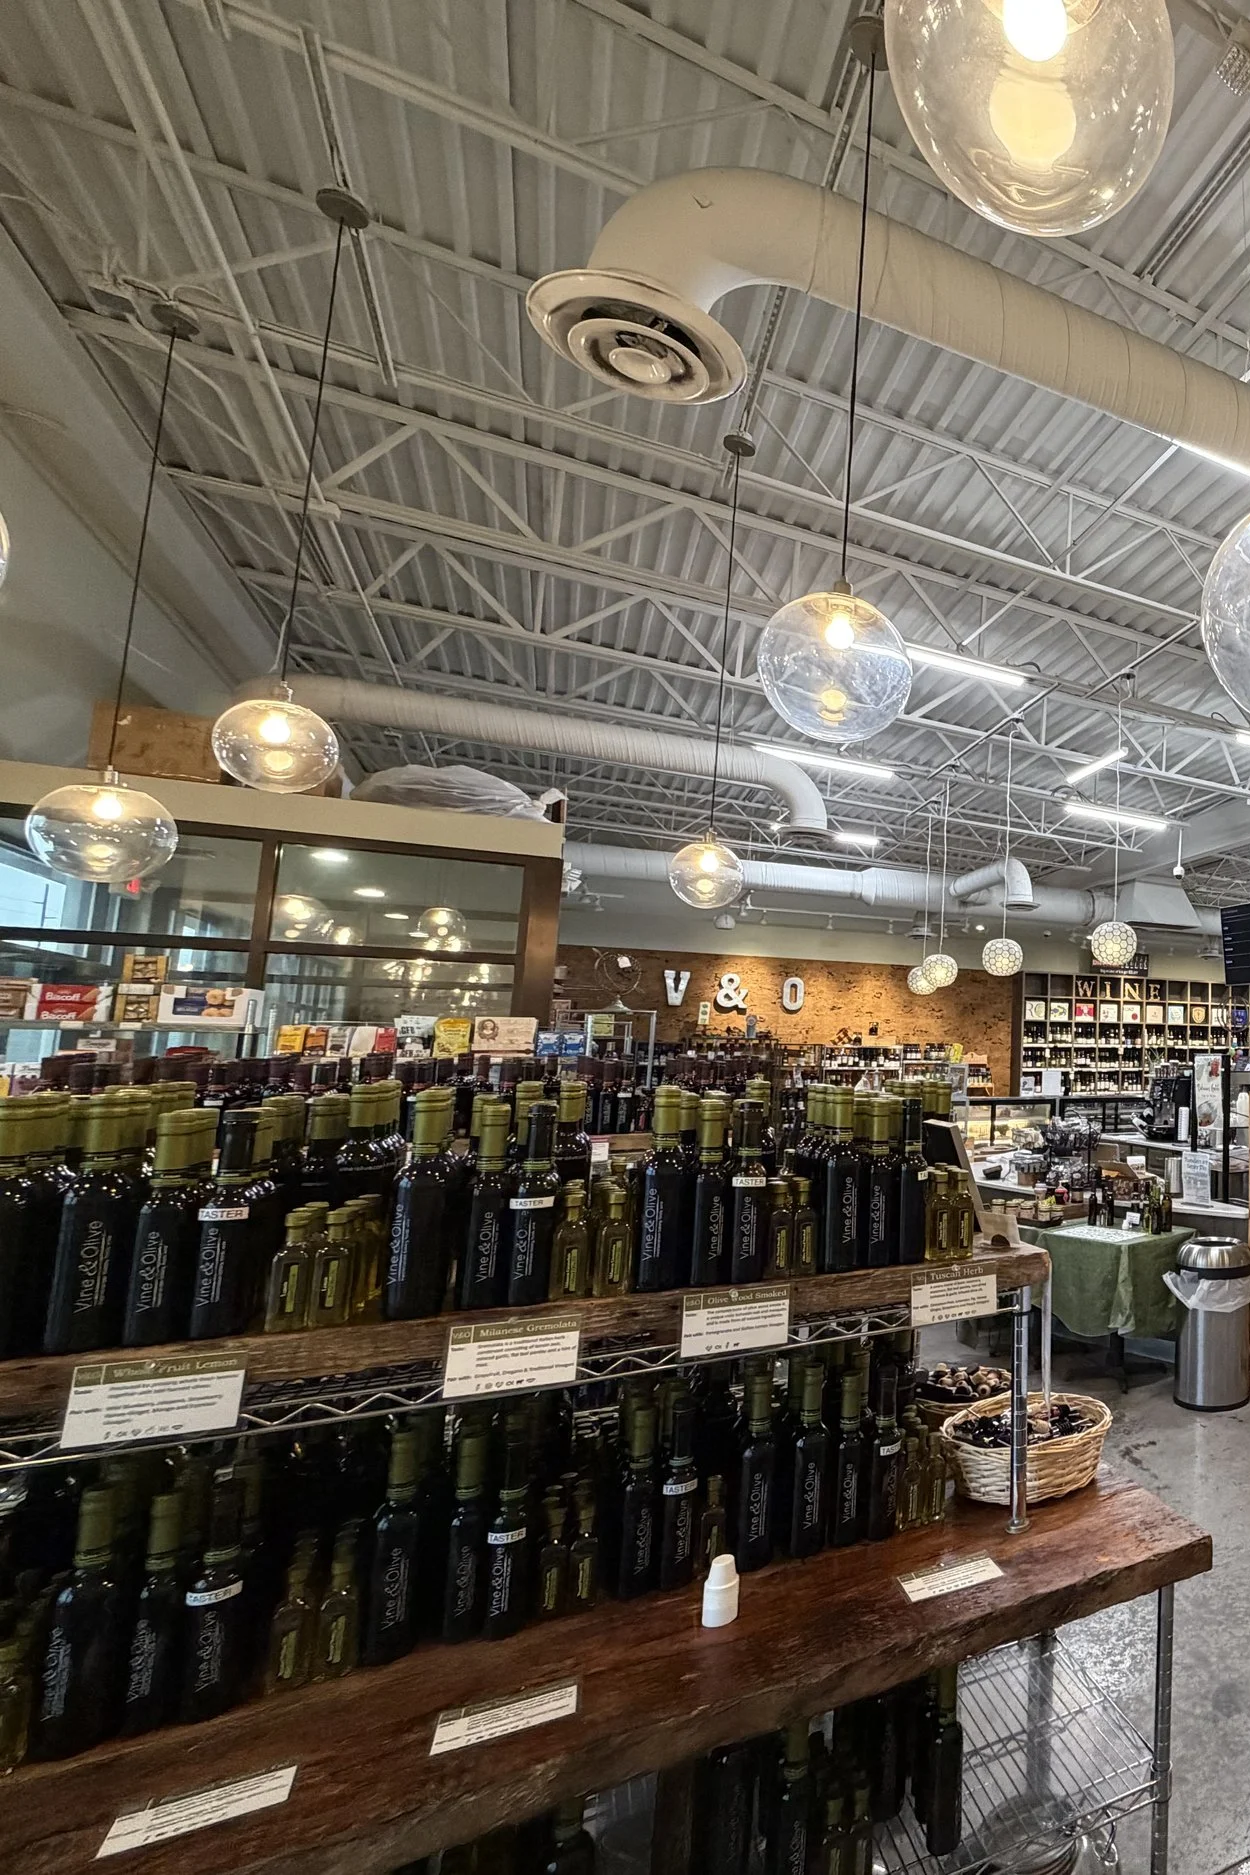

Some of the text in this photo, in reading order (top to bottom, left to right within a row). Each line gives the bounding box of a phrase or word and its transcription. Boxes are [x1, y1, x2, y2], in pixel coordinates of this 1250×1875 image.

[45, 991, 81, 1002] Biscoff
[664, 969, 805, 1011] V & O
[1076, 980, 1161, 1001] WINE
[40, 1011, 77, 1021] Biscoff
[735, 1178, 764, 1186] TASTER
[200, 1209, 244, 1219] TASTER
[641, 1188, 657, 1262] Vine & Olive
[842, 1176, 853, 1244] Vine & Olive
[870, 1185, 881, 1244] Vine & Olive
[707, 1196, 721, 1260] Vine & Olive
[740, 1196, 752, 1260] Vine & Olive
[387, 1203, 404, 1286] Vine & Olive
[474, 1211, 494, 1284] Vine & Olive
[74, 1220, 104, 1314] Vine & Olive
[136, 1231, 160, 1313] Vine & Olive
[196, 1227, 220, 1307] Vine & Olive
[513, 1253, 526, 1280] Vine
[930, 1270, 961, 1281] Tuscan
[963, 1266, 984, 1276] Herb
[707, 1296, 729, 1305] Olive
[755, 1289, 787, 1299] Smoked
[479, 1320, 577, 1338] Milanese Gremolata
[196, 1358, 238, 1370] Lemon
[749, 1473, 763, 1543] Vine & Olive
[803, 1462, 816, 1530] Vine & Olive
[842, 1502, 851, 1524] Vine
[489, 1531, 524, 1543] TASTER
[382, 1600, 397, 1630] Vine
[490, 1590, 502, 1617] Vine
